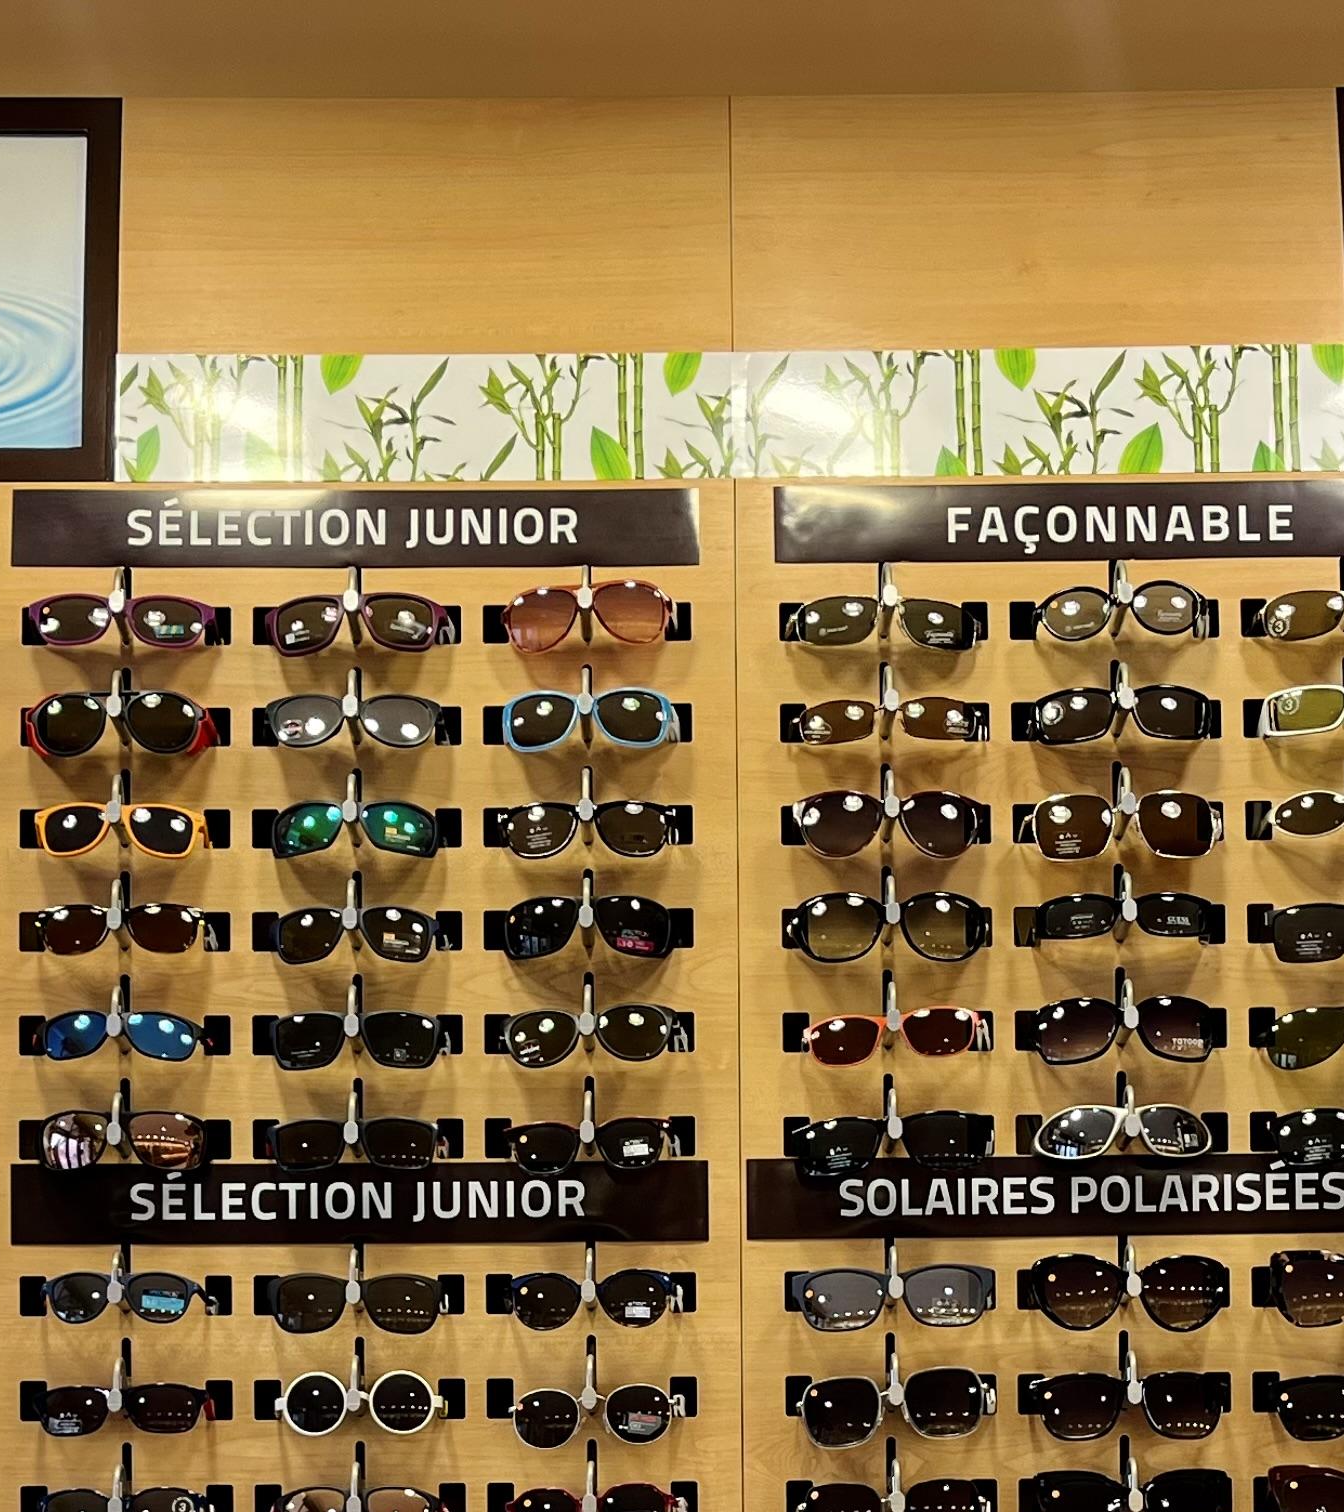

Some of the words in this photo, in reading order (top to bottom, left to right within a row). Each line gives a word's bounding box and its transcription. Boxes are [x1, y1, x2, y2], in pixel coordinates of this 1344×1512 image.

[126, 498, 387, 546] SÉLECTION
[405, 508, 578, 548] JUNIOR
[946, 504, 1295, 554] FAÇONNABLE
[131, 1171, 393, 1221] SÉLECTION
[413, 1180, 587, 1222] JUNIOR
[839, 1176, 1056, 1217] SOLAIRES
